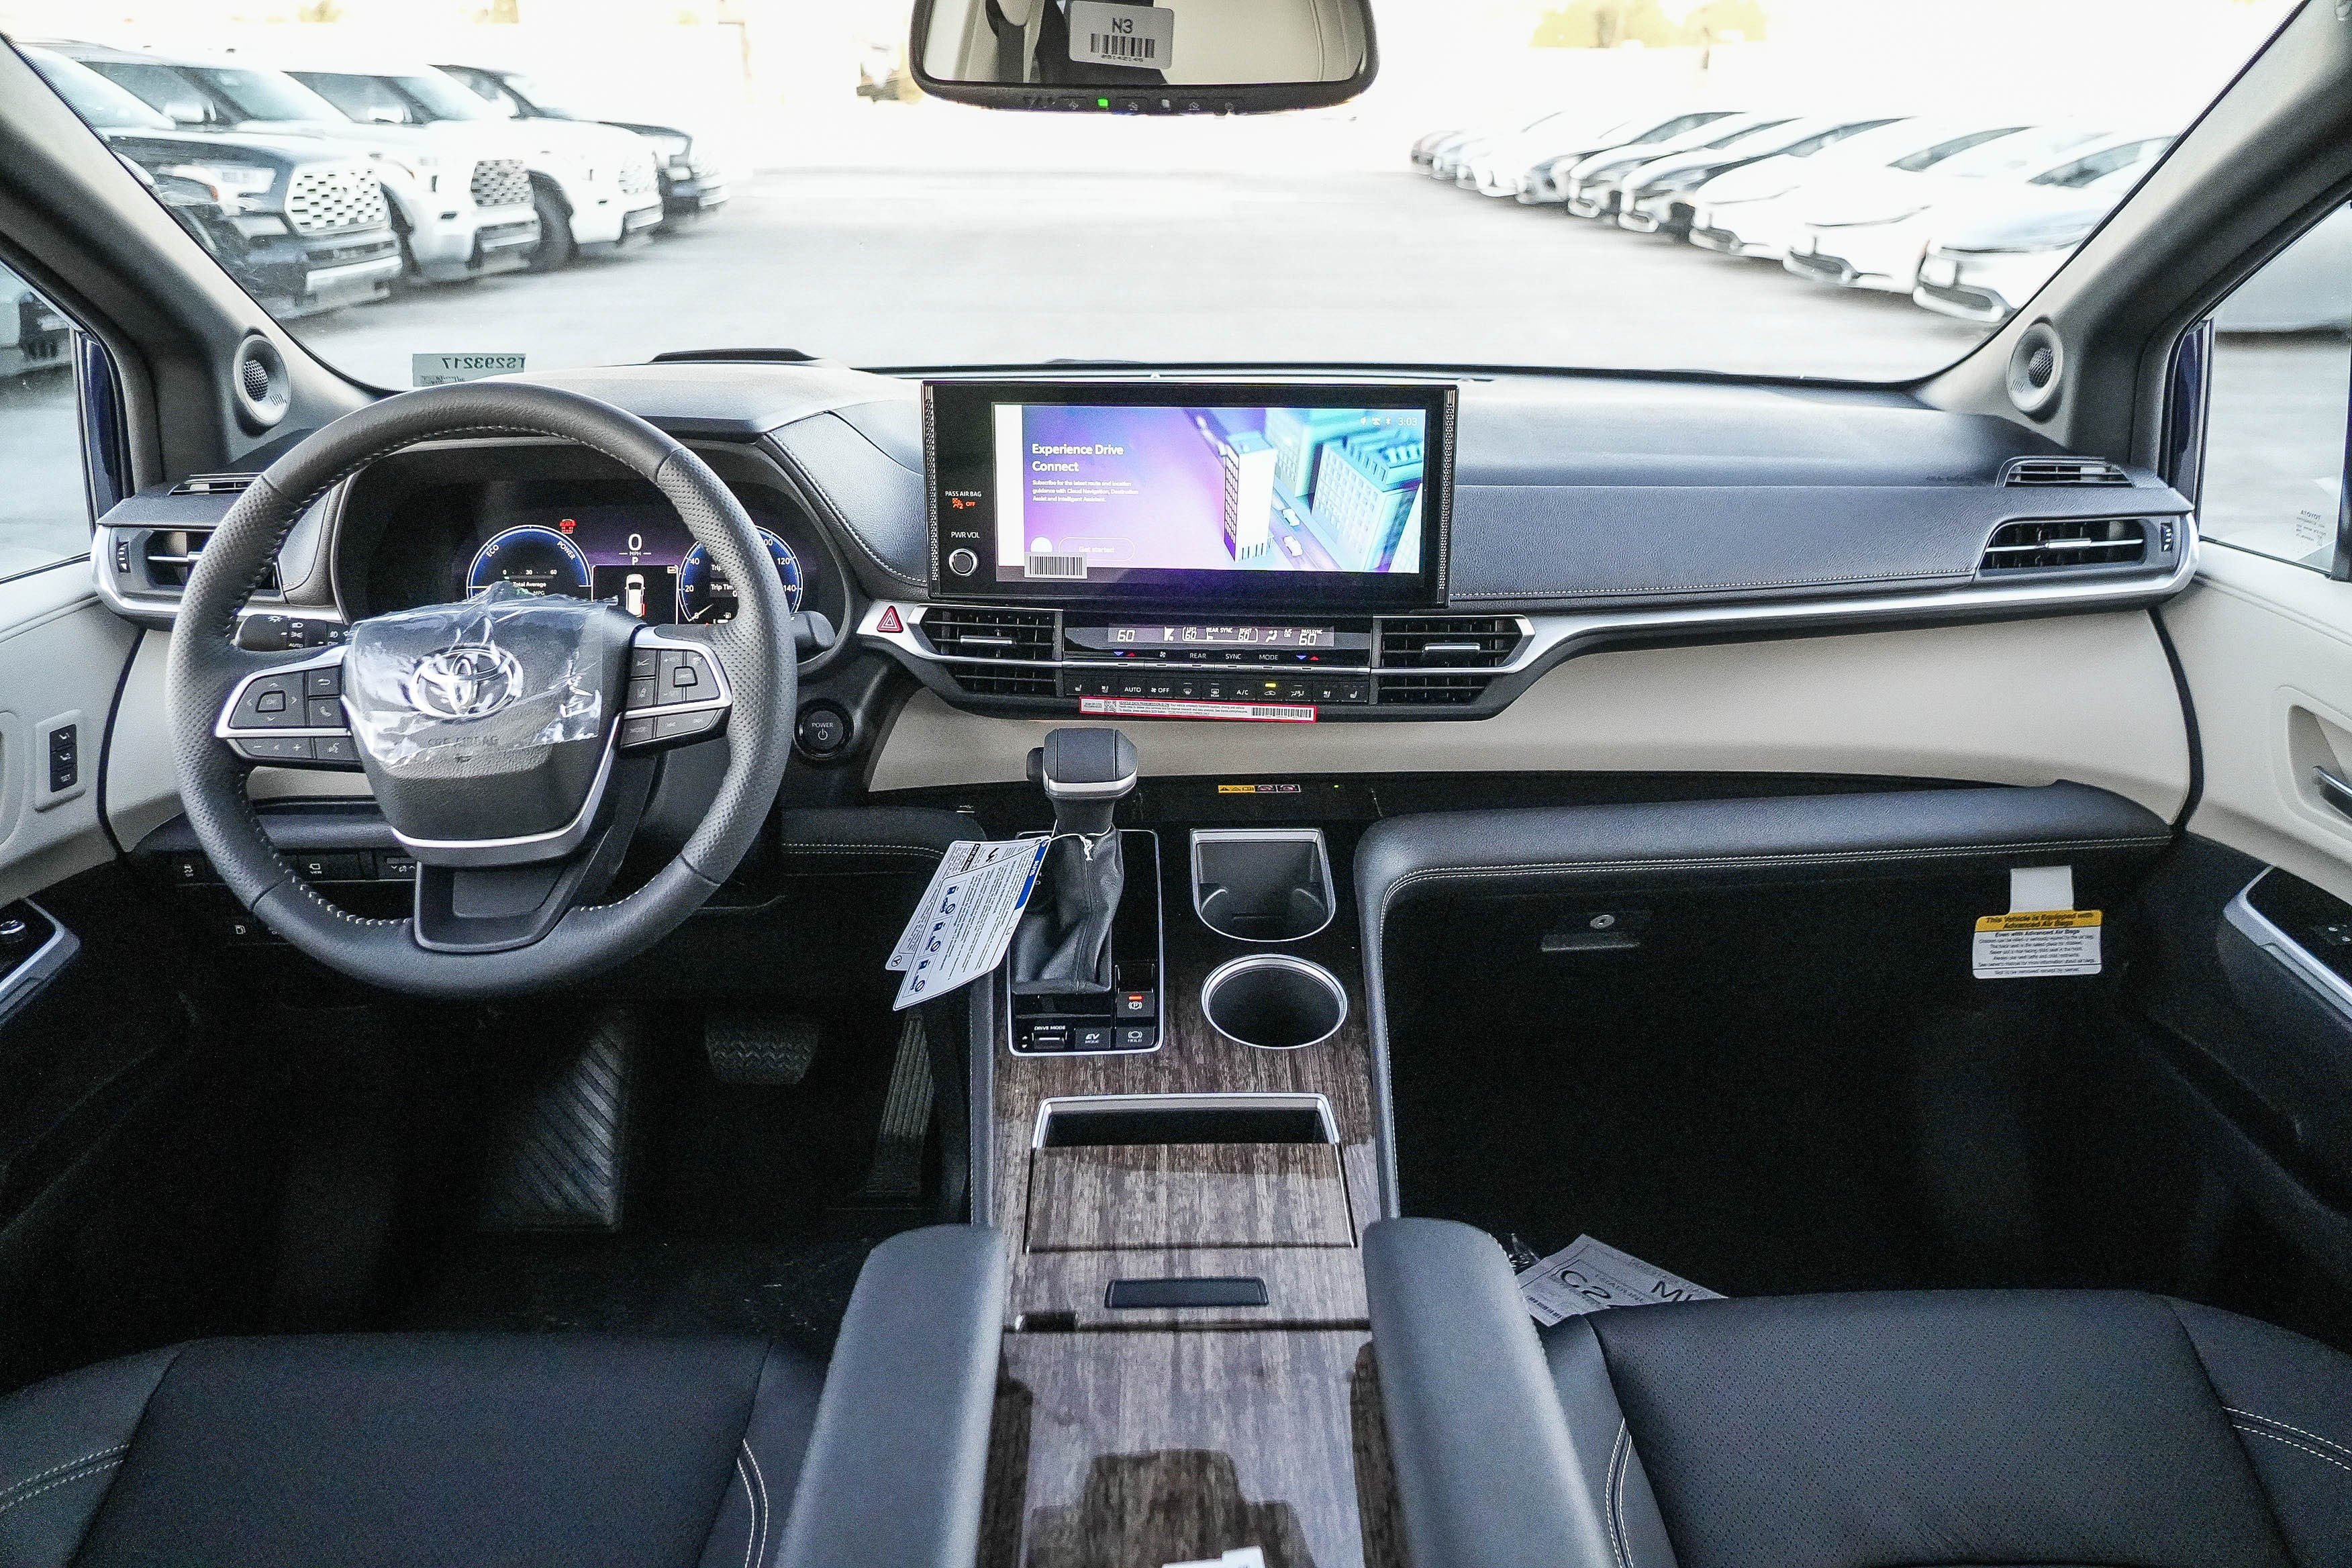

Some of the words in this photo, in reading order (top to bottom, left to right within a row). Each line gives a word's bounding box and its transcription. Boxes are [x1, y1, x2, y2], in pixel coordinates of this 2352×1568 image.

[1112, 17, 1134, 34] N3
[1398, 417, 1418, 426] 3:03
[1032, 443, 1093, 456] Experience
[1095, 444, 1124, 455] Drive
[1032, 460, 1079, 472] Connect
[628, 533, 642, 550] 0
[487, 544, 499, 558] ECO
[556, 540, 576, 560] POWER
[632, 556, 639, 565] P
[1117, 629, 1136, 642] 60
[1185, 632, 1197, 640] 60
[1238, 632, 1250, 640] 60
[1299, 633, 1317, 646] 60
[1029, 860, 1040, 877] AVIS
[2004, 916, 2030, 924] Vehicle
[1561, 1270, 1612, 1304] C2
[1651, 1281, 1694, 1302] M
